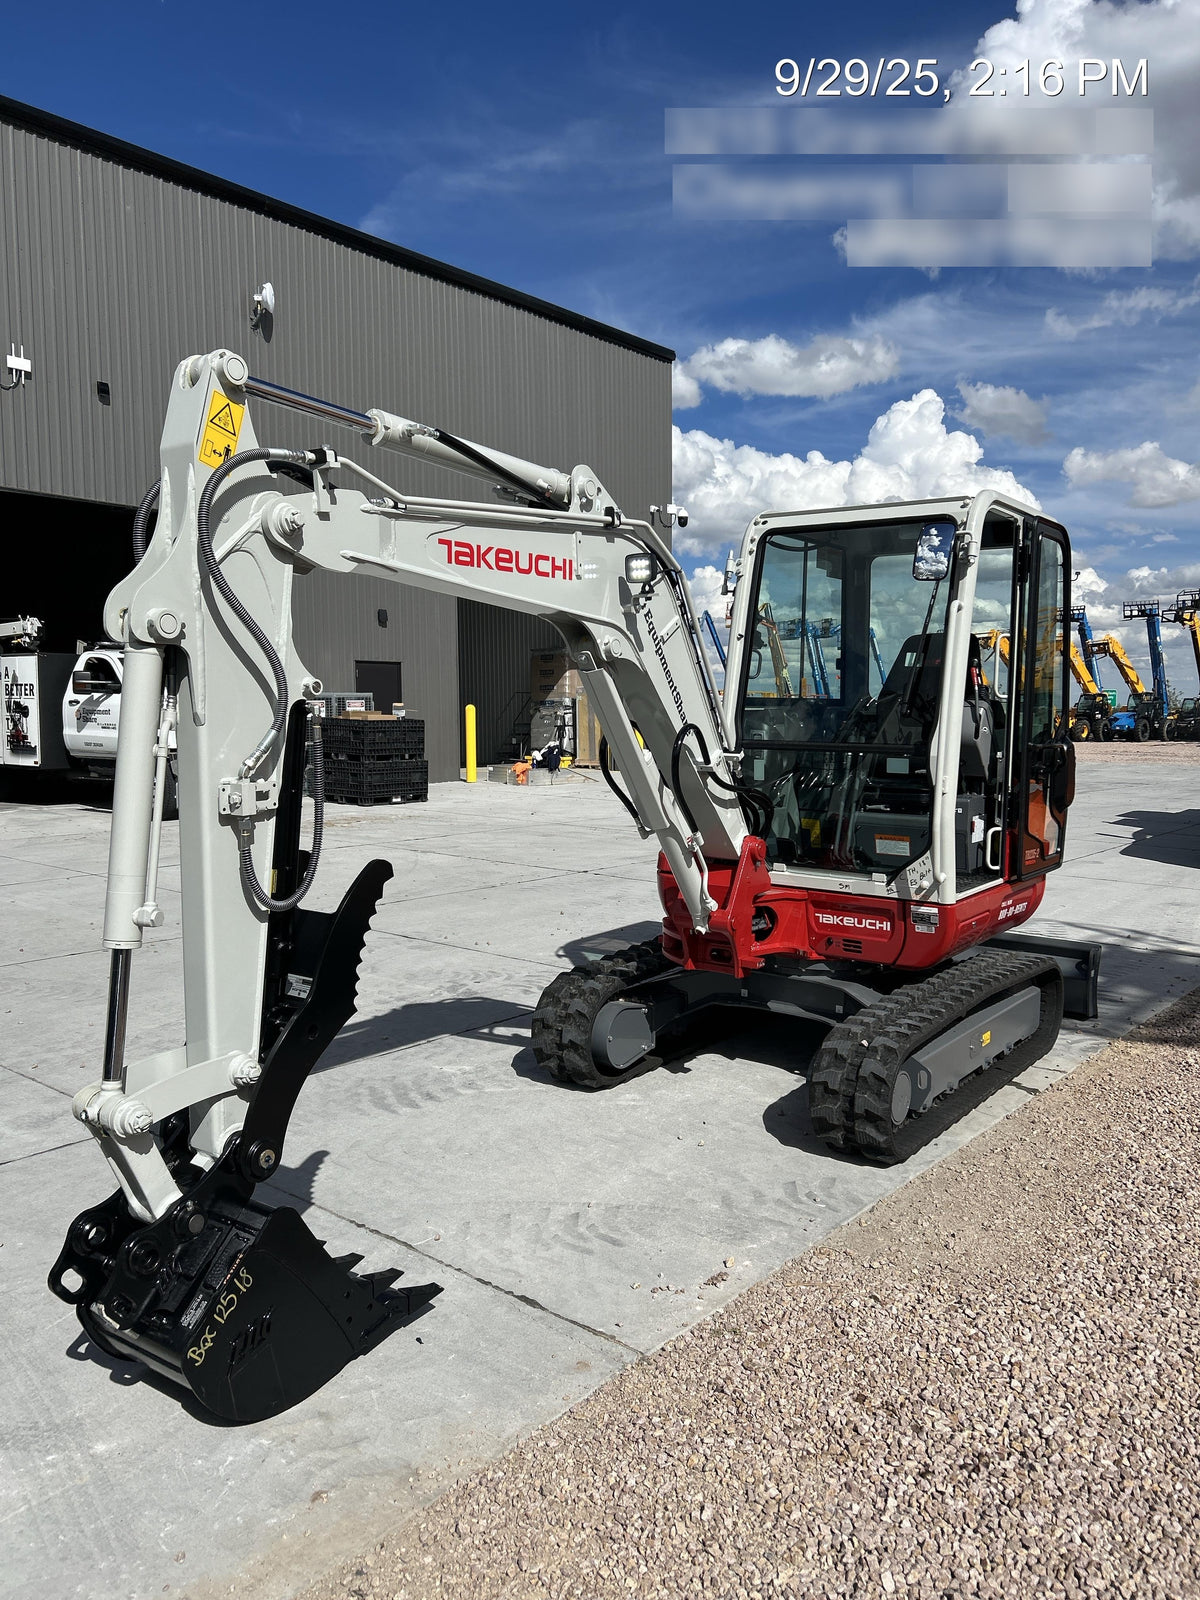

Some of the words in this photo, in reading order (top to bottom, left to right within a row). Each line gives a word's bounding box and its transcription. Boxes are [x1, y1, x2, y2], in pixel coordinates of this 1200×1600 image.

[437, 537, 573, 581] TAKEUCHI
[4, 666, 10, 680] A
[643, 608, 693, 737] EquipmentShar
[4, 683, 35, 697] BETTER
[815, 913, 891, 931] TAKEUCHI
